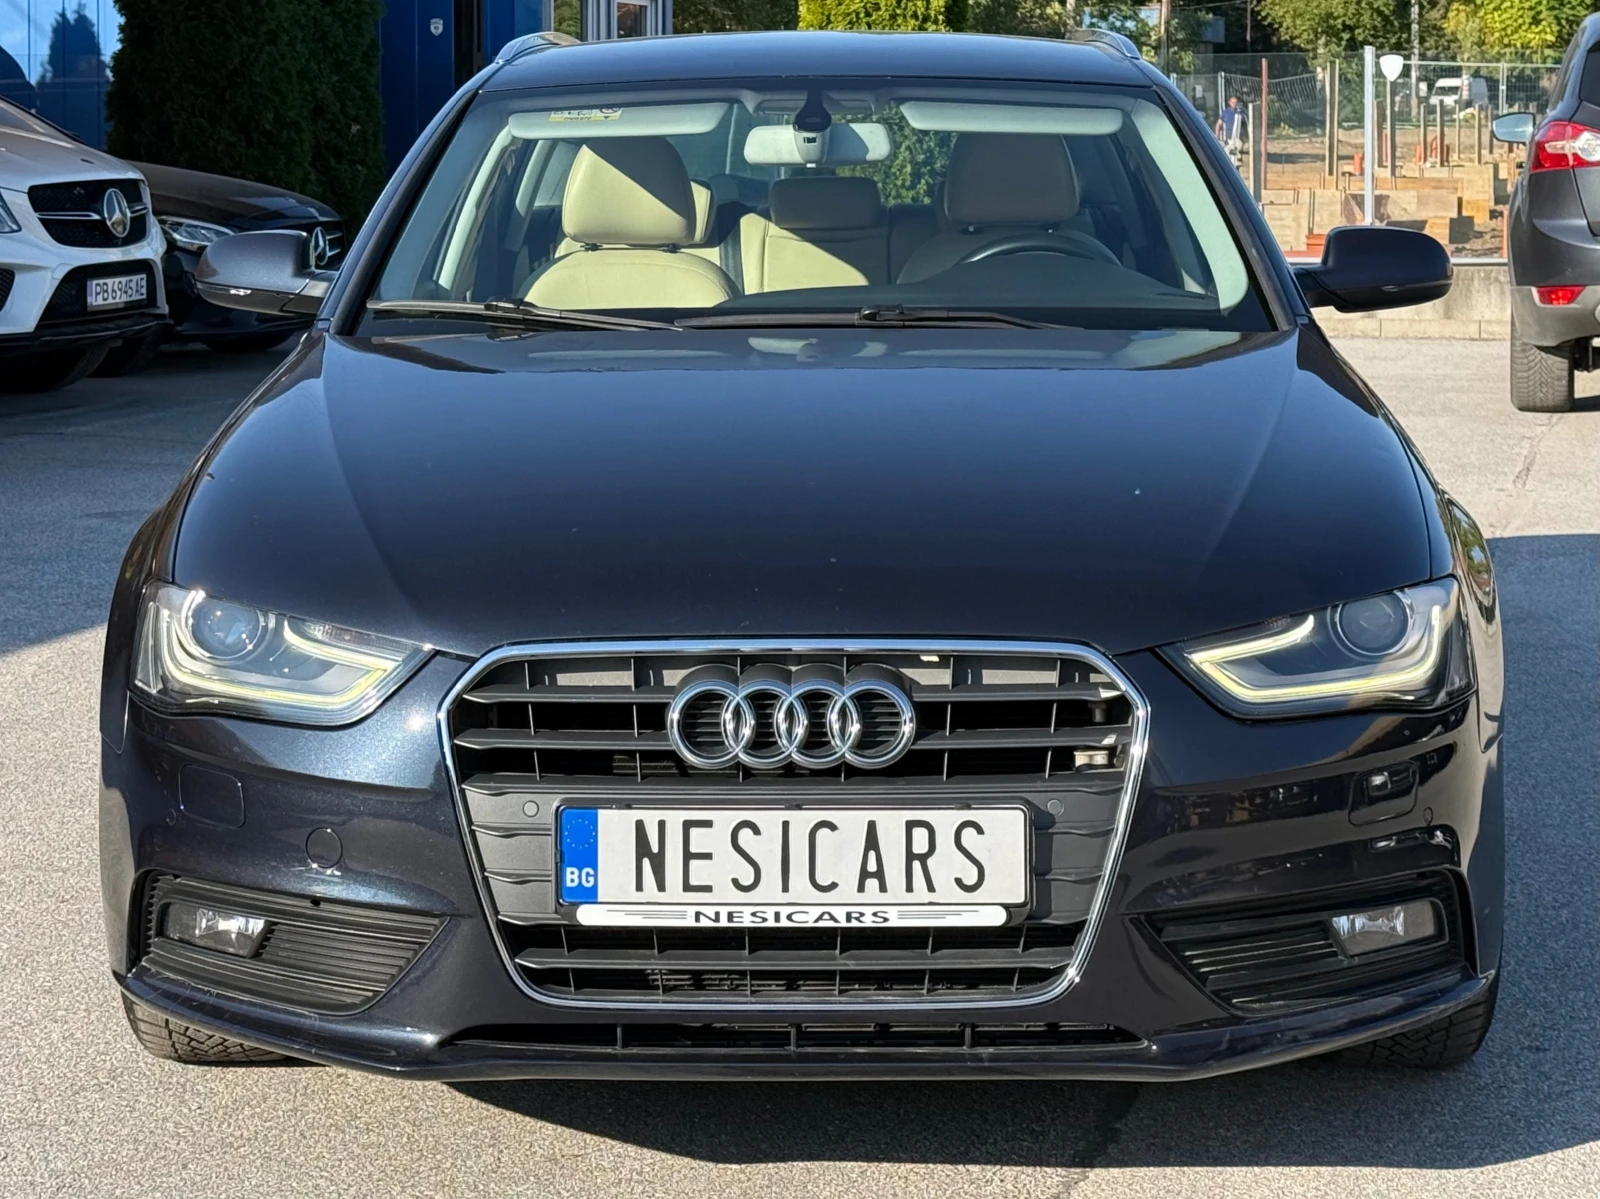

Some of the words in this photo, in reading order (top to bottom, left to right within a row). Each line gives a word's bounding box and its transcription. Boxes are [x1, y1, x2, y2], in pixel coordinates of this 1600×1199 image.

[95, 282, 109, 303] PB
[111, 279, 133, 300] 6945
[135, 277, 144, 297] AE
[635, 819, 985, 893] NESICARS
[566, 867, 595, 888] BG
[694, 910, 890, 924] NESICARS
